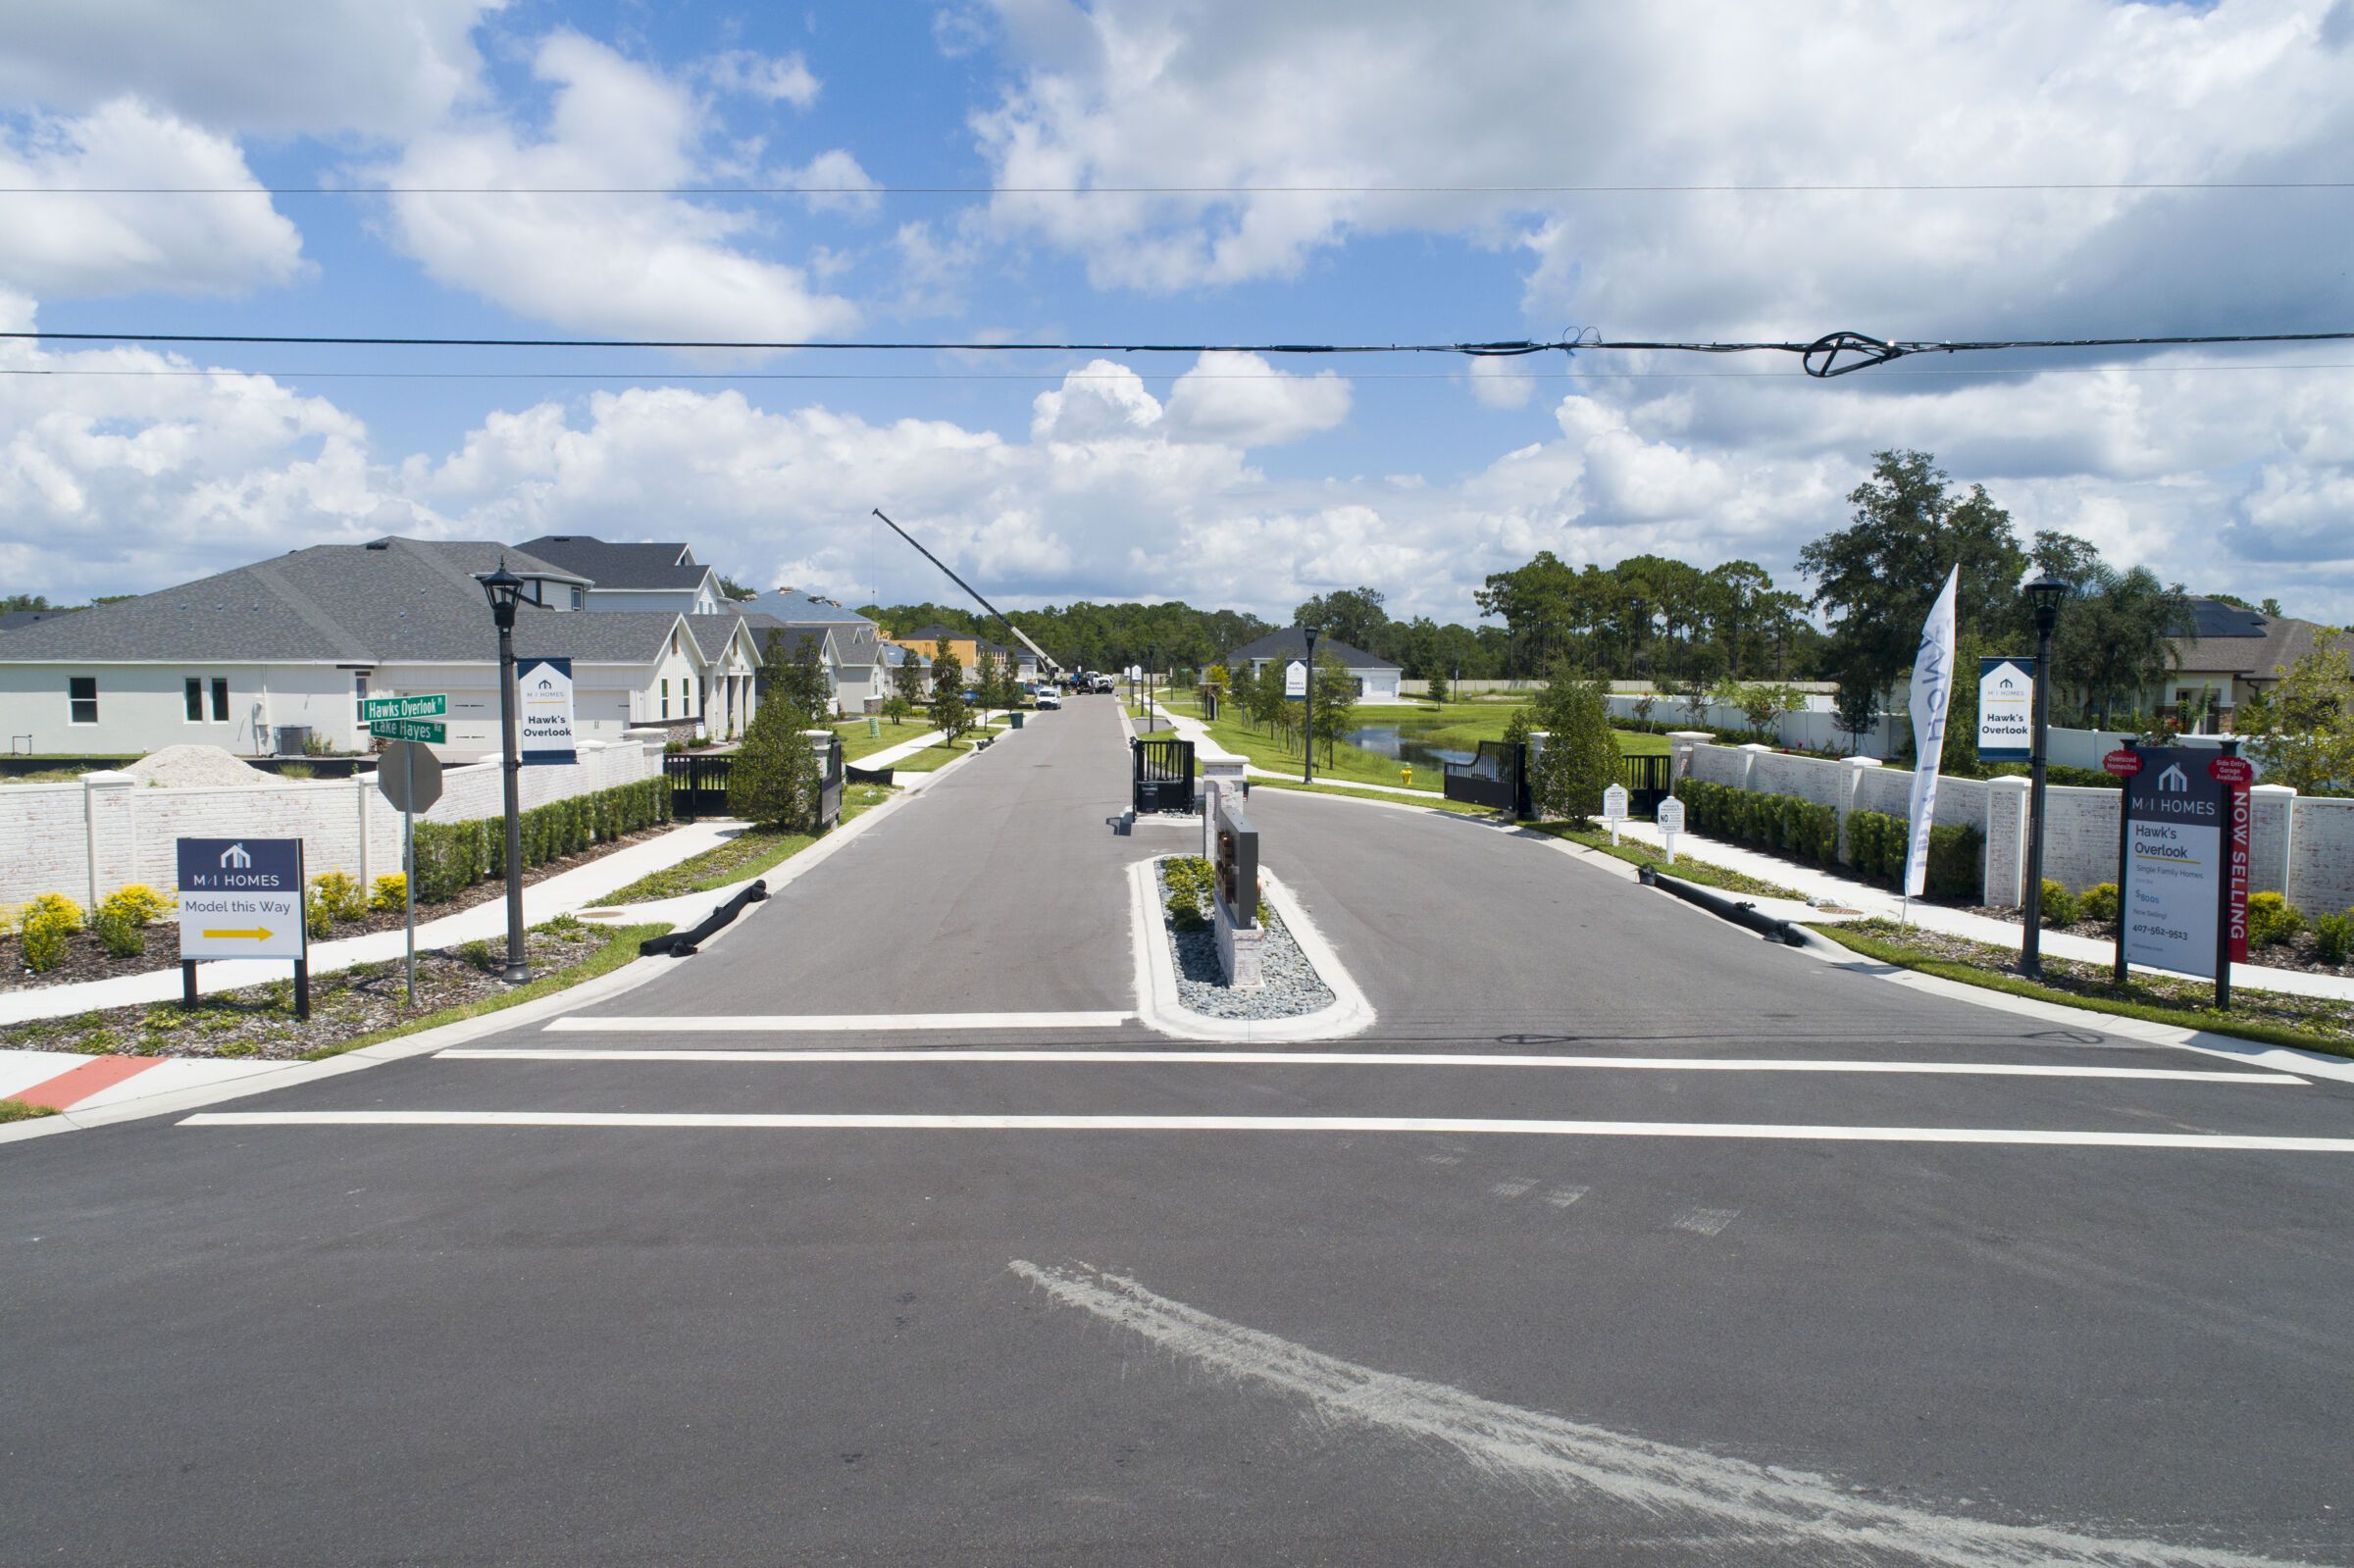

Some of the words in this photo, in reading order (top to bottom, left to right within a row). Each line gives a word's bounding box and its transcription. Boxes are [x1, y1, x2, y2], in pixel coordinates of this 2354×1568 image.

[369, 701, 399, 719] Hawks
[401, 697, 436, 717] Overlook
[528, 715, 566, 724] Hawk's
[1987, 713, 2024, 722] Hawk's
[374, 720, 396, 734] Lake
[400, 720, 432, 741] Hayes
[434, 723, 442, 732] Rd
[523, 727, 572, 736] Overlook
[1981, 726, 2028, 734] Overlook
[2161, 798, 2216, 816] HOMES
[1661, 814, 1668, 823] NO
[2232, 791, 2248, 845] NOW
[2135, 824, 2177, 839] Hawk's
[2134, 841, 2188, 859] Overlook
[2136, 864, 2156, 875] Single
[2158, 866, 2178, 878] Family
[2179, 870, 2204, 880] Homes
[225, 875, 280, 886] HOMES
[2229, 850, 2247, 939] SELLING
[185, 900, 228, 913] Model
[231, 900, 256, 913] this
[259, 900, 291, 916] Way
[2132, 924, 2188, 941] 407-562-9513
